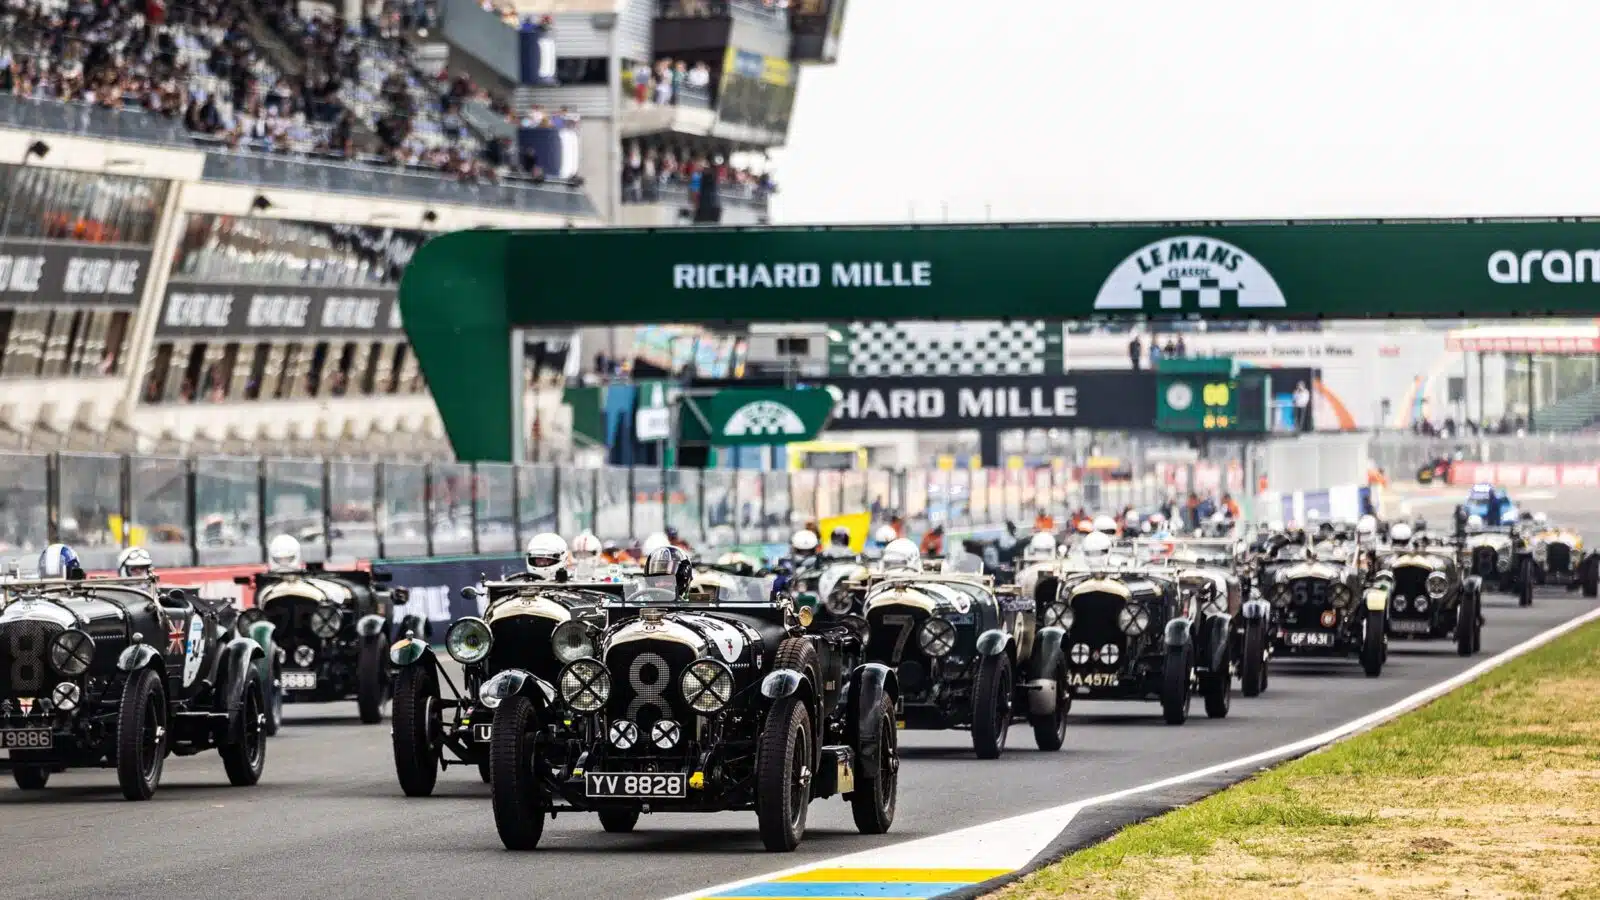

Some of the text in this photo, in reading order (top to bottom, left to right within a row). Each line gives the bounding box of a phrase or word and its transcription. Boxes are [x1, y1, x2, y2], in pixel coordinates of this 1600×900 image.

[1137, 241, 1243, 274] LE MANS
[673, 261, 932, 289] RICHARD MILLE
[1168, 267, 1211, 279] CLASSIC
[958, 387, 1077, 417] MILLE
[883, 614, 914, 666] 7
[8, 624, 45, 692] 8
[627, 652, 672, 742] 8
[6, 731, 50, 746] 9886
[592, 775, 681, 794] YV 8828
